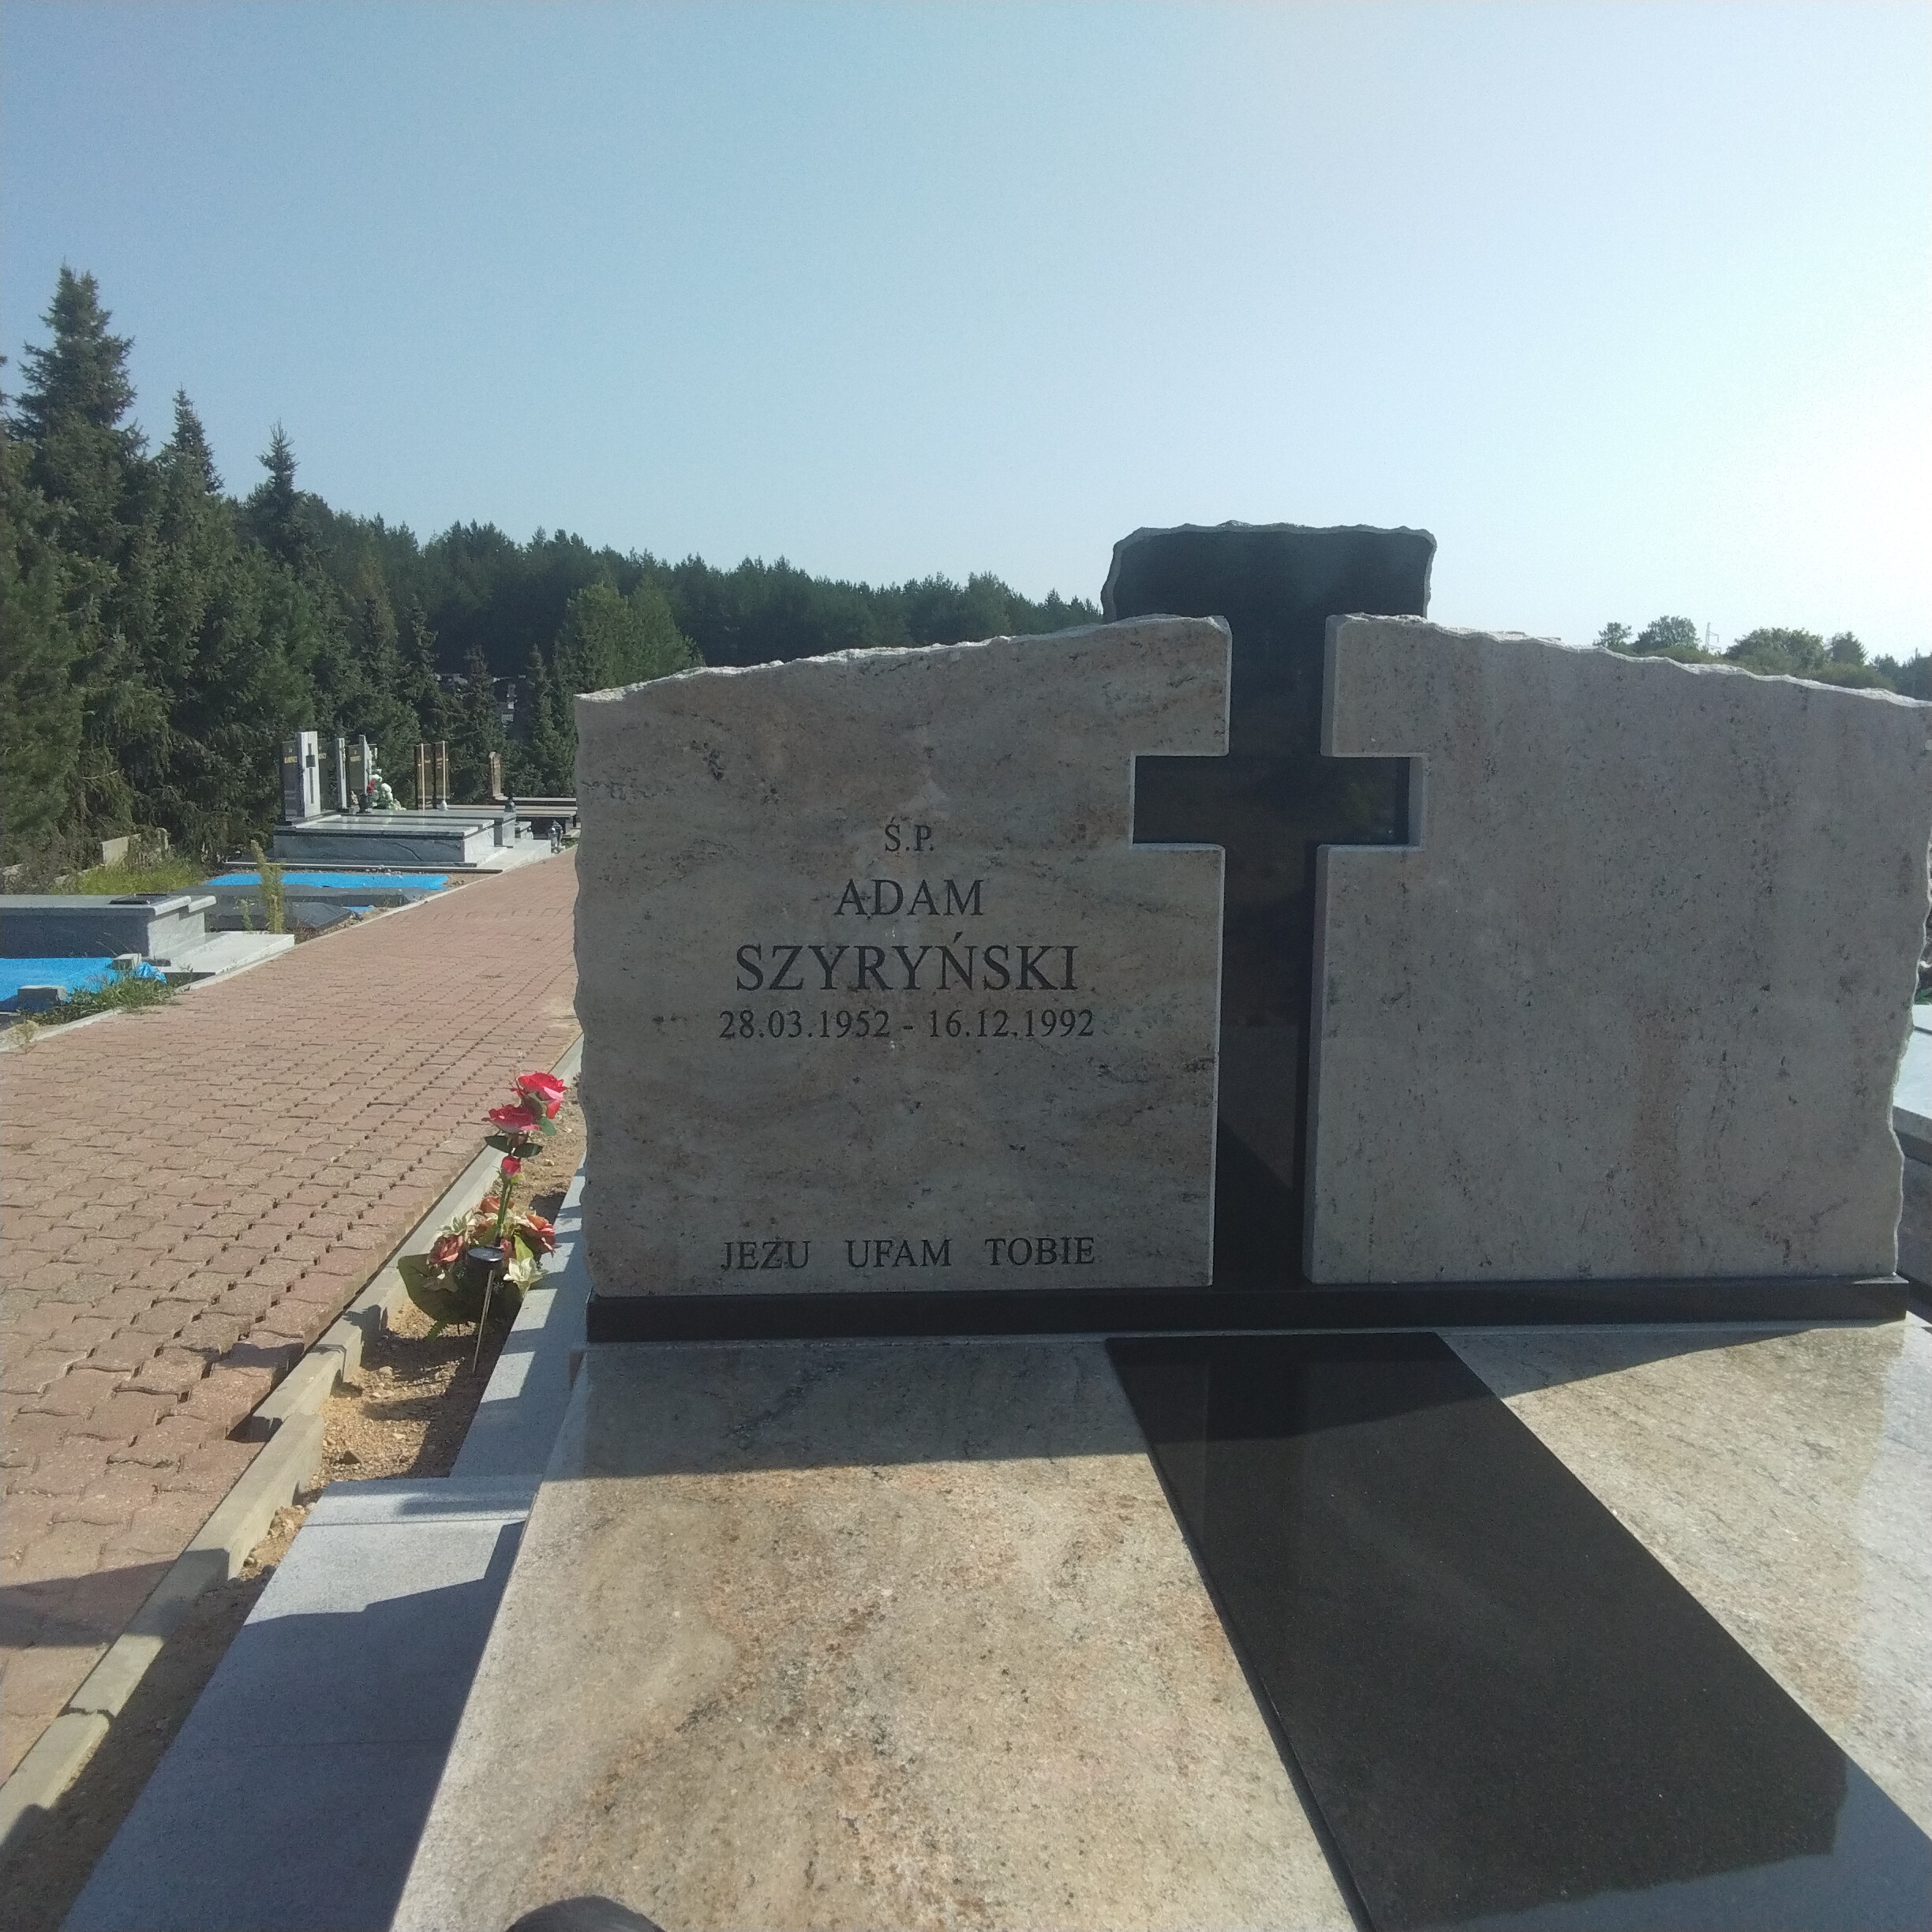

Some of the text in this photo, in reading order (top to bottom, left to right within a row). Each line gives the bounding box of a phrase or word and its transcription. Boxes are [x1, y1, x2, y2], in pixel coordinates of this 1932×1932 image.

[884, 816, 934, 852] Ś.P.
[833, 878, 983, 916] ADAM
[736, 931, 1079, 991] SZYRYŃSKI
[719, 1009, 891, 1039] 28.03.1952
[930, 1008, 1095, 1038] 16.12.1992
[845, 1237, 952, 1269] UFAM
[984, 1237, 1095, 1266] TOBIE
